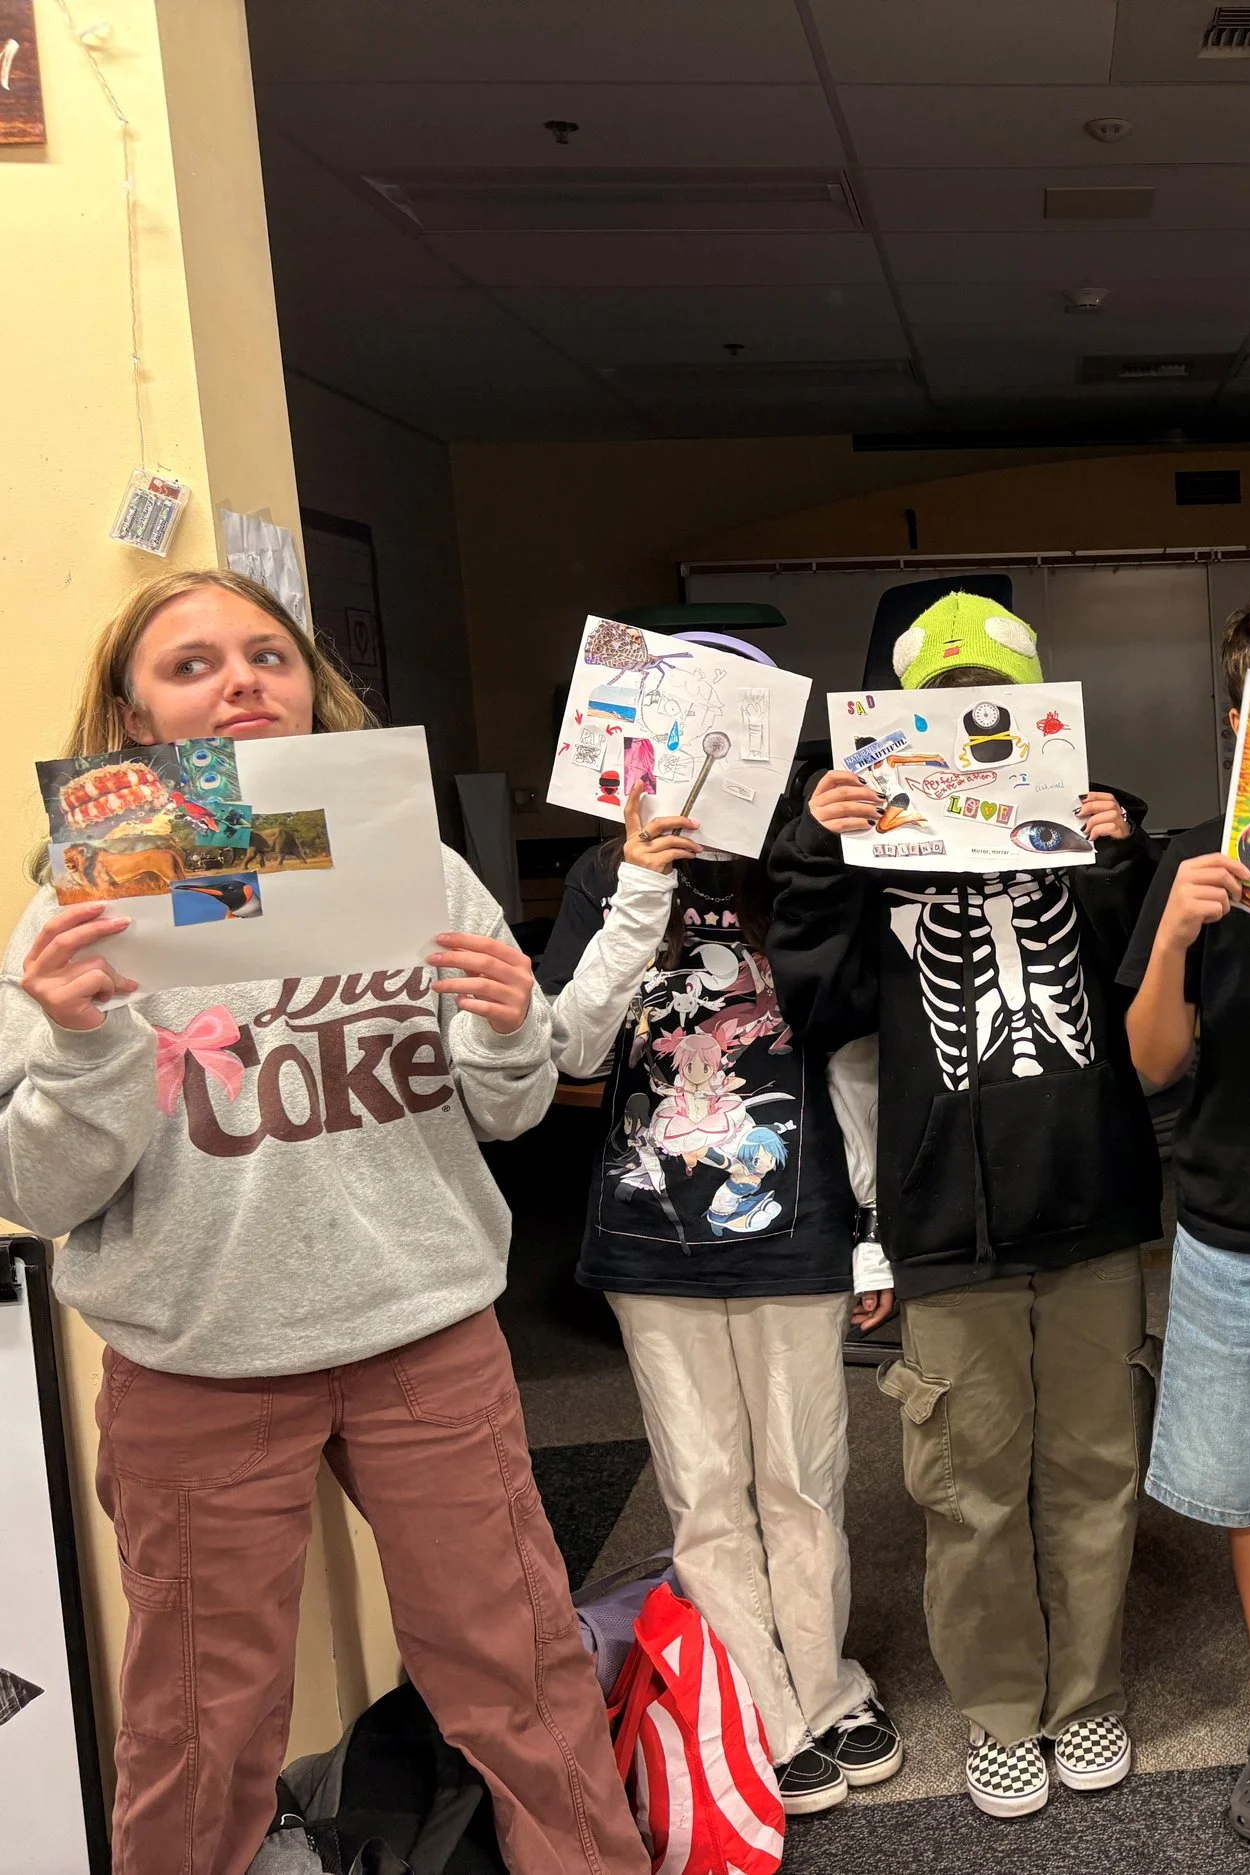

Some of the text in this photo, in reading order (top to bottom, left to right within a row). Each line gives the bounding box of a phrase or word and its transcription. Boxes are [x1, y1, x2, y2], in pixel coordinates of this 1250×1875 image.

[848, 694, 876, 716] SAD
[858, 738, 907, 768] BEAUTIFUL
[947, 795, 1013, 825] LOVE
[873, 840, 946, 857] FRIEND
[183, 1004, 454, 1157] Coke
